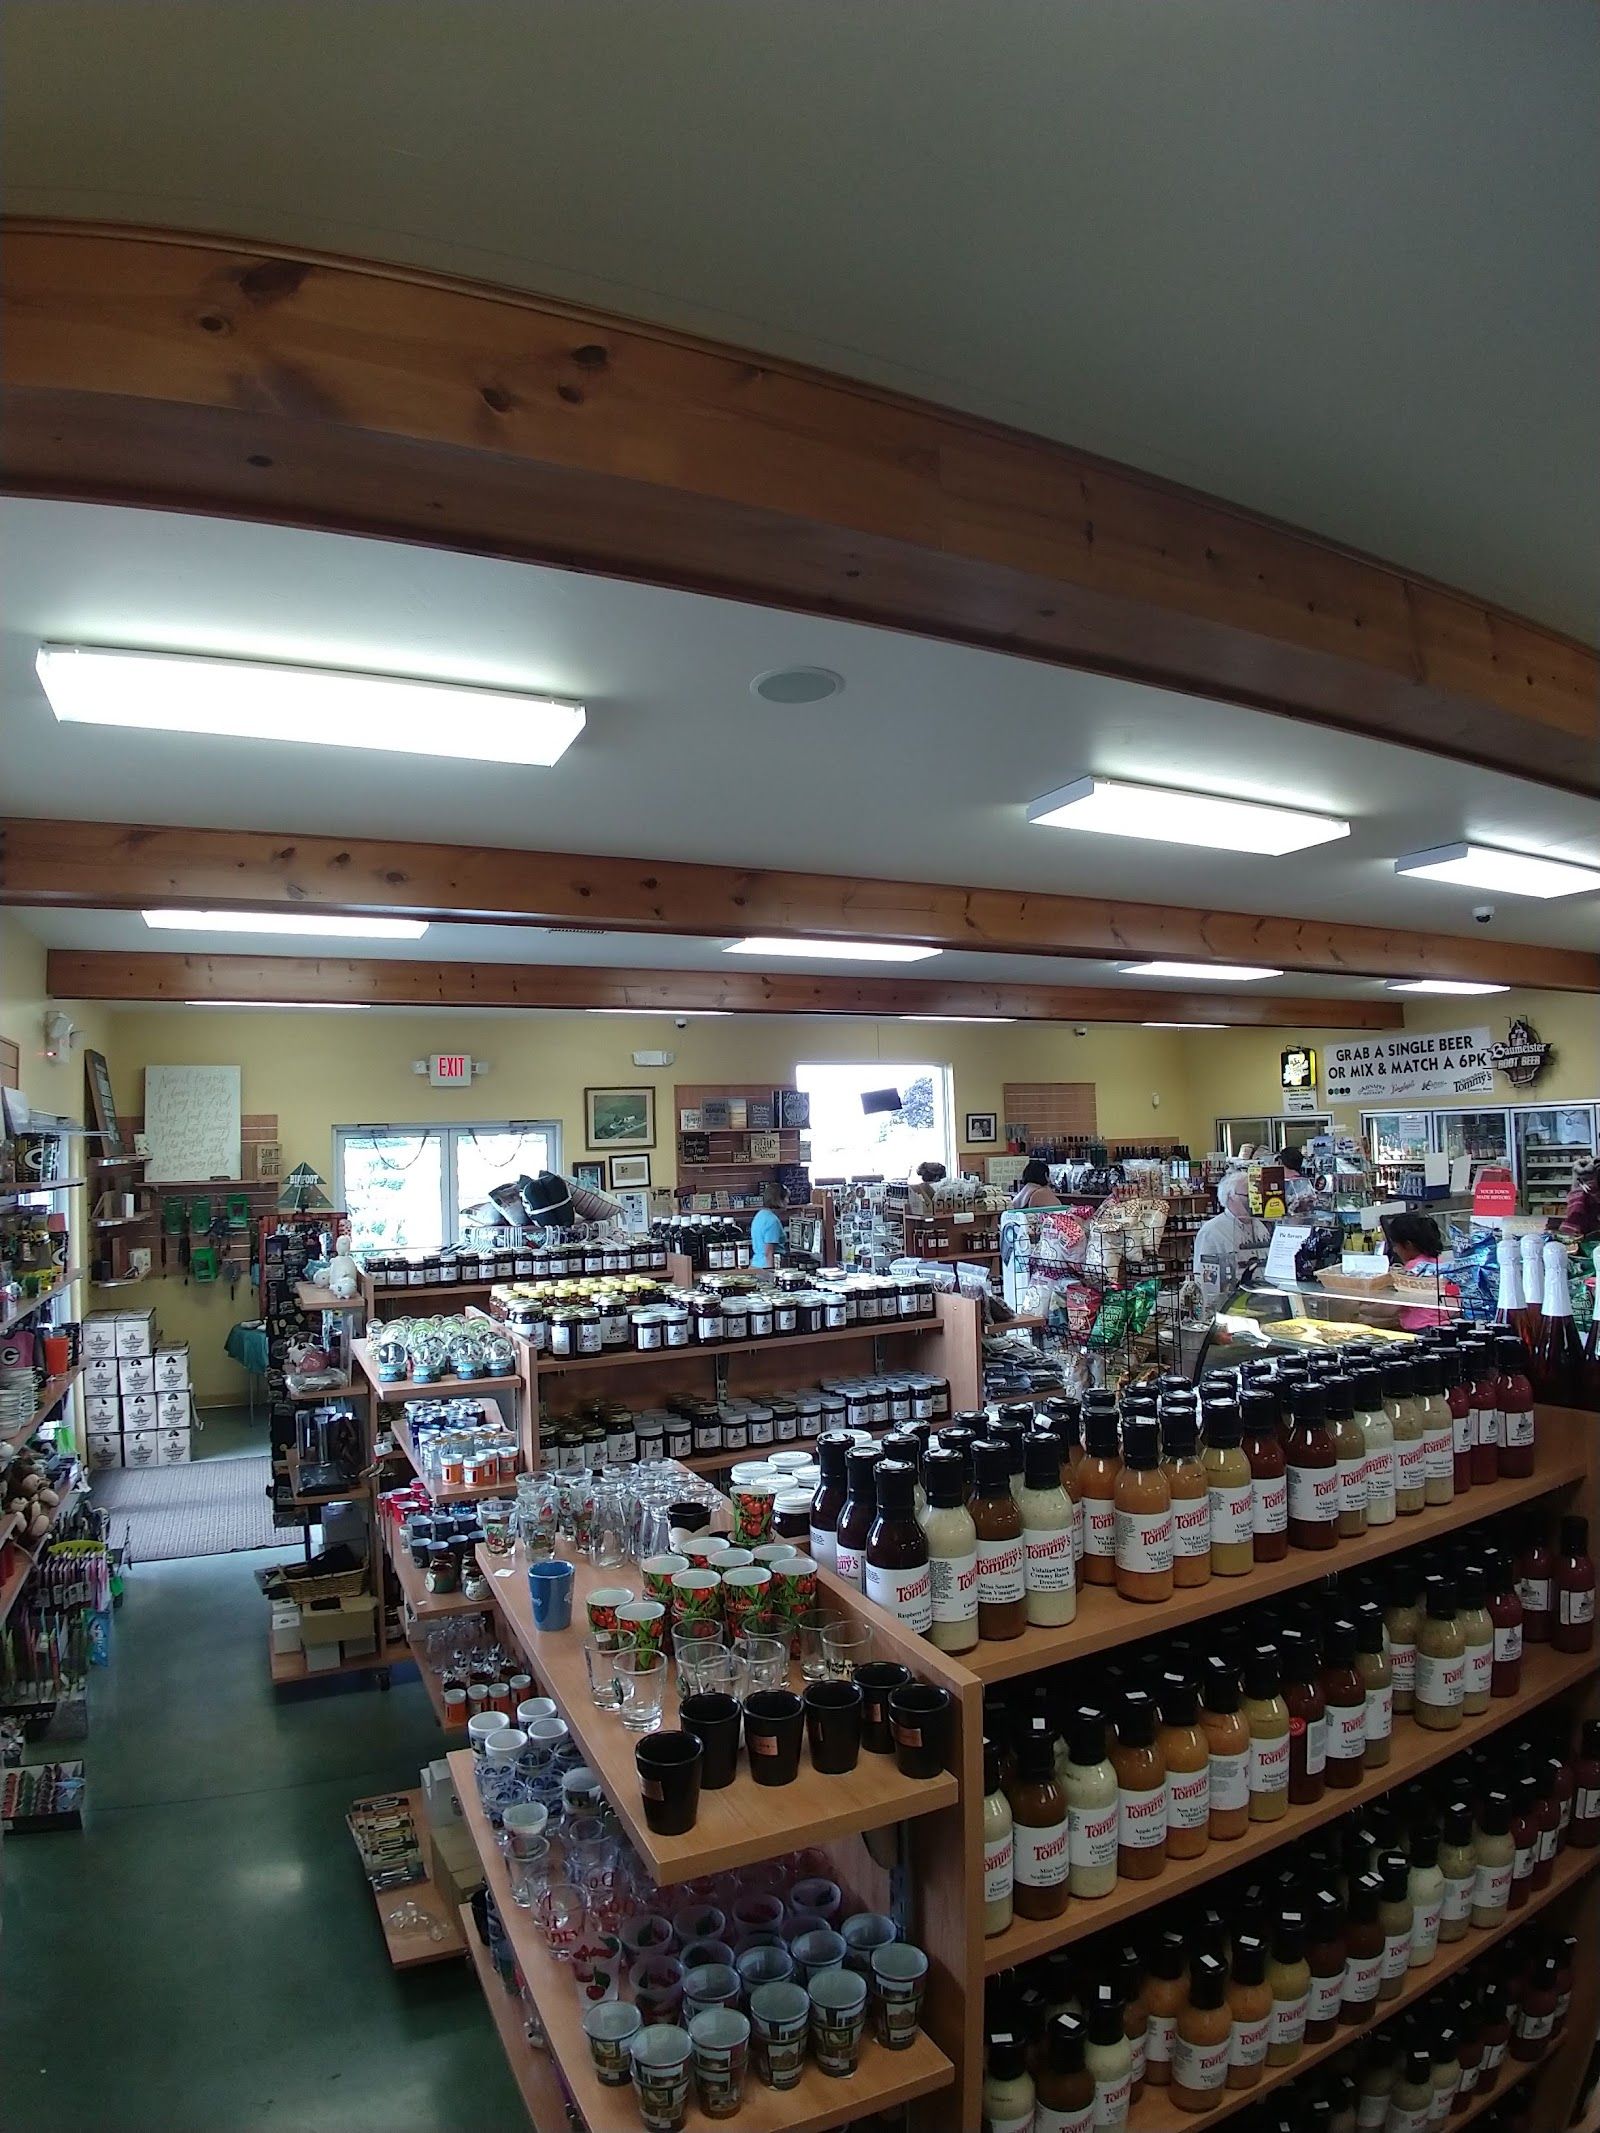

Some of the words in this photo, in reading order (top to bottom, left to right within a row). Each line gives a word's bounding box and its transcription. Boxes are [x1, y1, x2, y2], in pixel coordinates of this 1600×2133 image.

[1336, 1047, 1370, 1062] GRAB
[1374, 1045, 1384, 1058] A
[1388, 1040, 1435, 1057] SINGLE
[1439, 1035, 1474, 1051] BEER
[1489, 1042, 1547, 1060] Baumeister
[439, 1057, 465, 1077] EXIT
[1328, 1066, 1346, 1079] OR
[1350, 1062, 1374, 1077] MIX
[1377, 1062, 1387, 1075] &
[1391, 1057, 1438, 1074] MATCH
[1443, 1055, 1454, 1070] A
[1459, 1052, 1487, 1068] 6PK
[1498, 1057, 1519, 1069] ROOT
[1521, 1055, 1541, 1066] BEER
[1453, 1071, 1493, 1093] Tommy's
[1026, 1535, 1071, 1559] Tommy's
